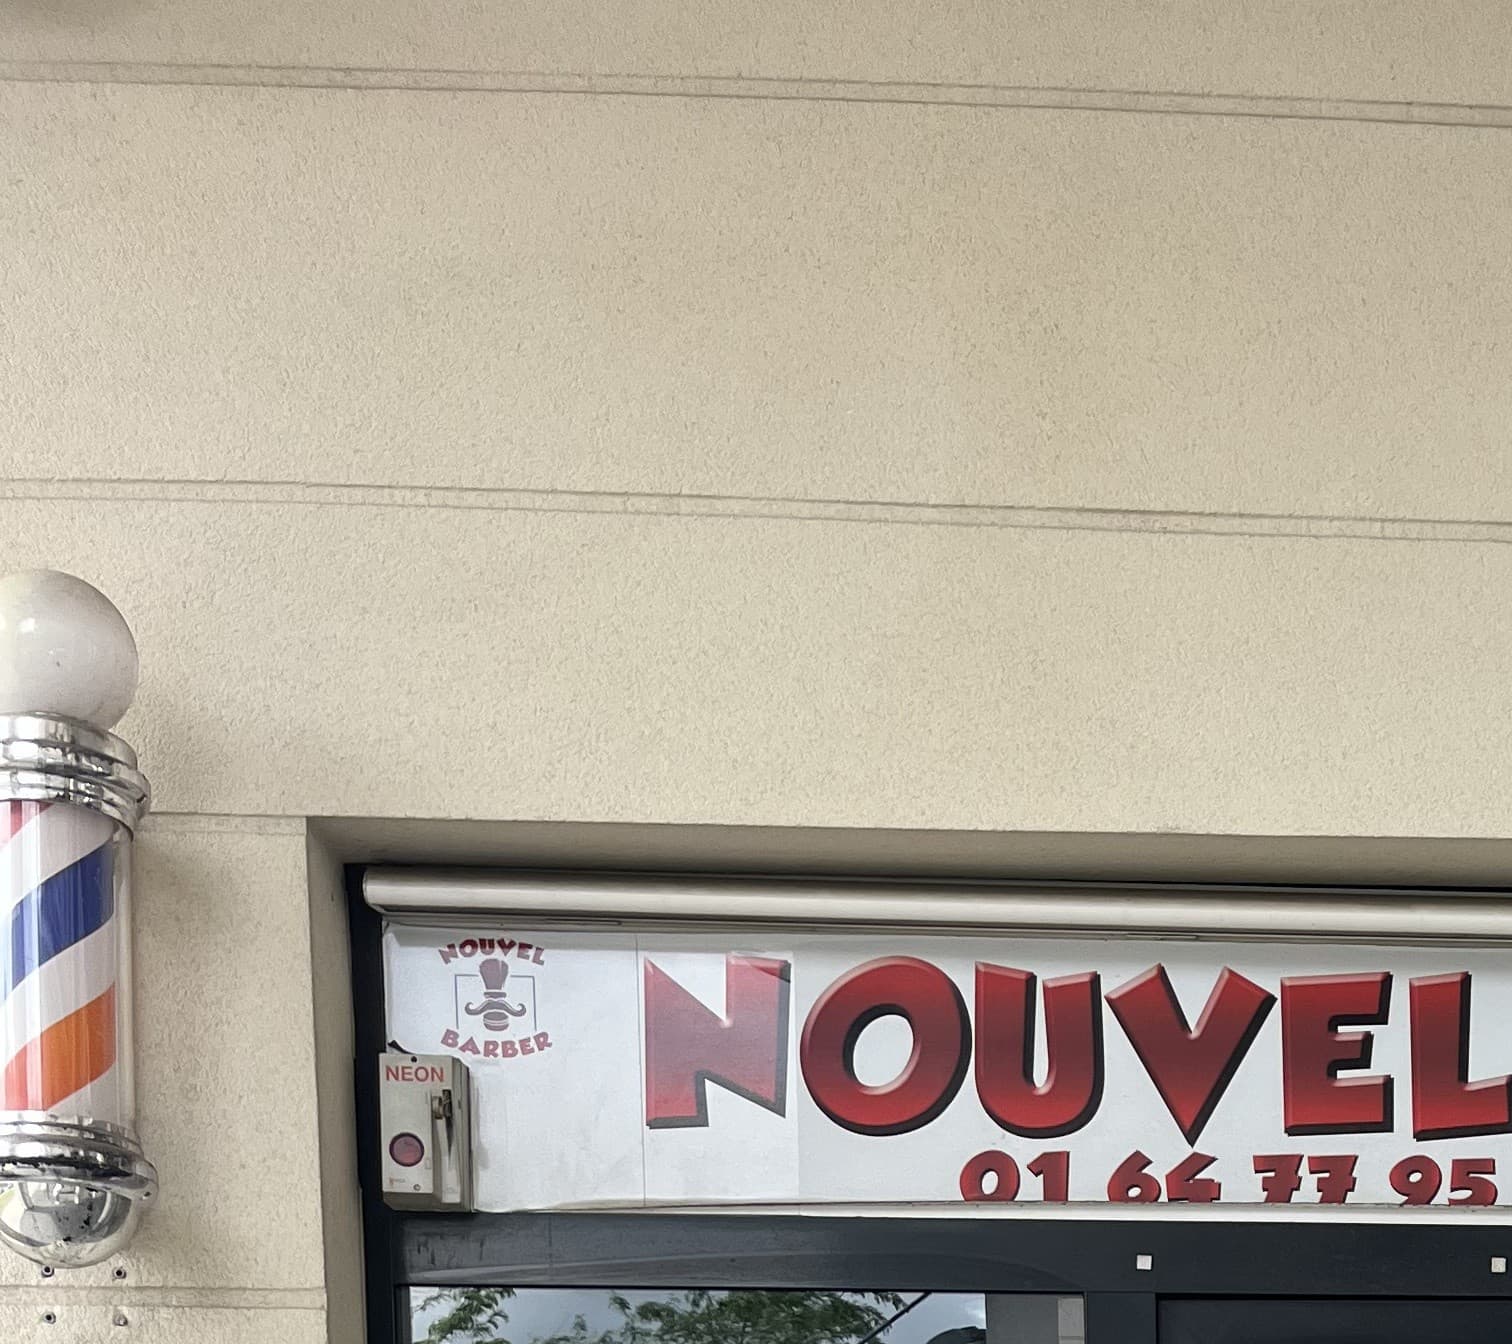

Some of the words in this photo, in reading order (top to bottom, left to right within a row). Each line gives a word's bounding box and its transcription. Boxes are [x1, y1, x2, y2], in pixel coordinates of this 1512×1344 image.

[438, 938, 546, 966] NOUVEL
[440, 1029, 553, 1058] BARBER
[385, 1065, 445, 1083] NEON
[959, 1149, 1071, 1203] 01
[1252, 1154, 1359, 1205] 77
[1389, 1154, 1499, 1207] 95
